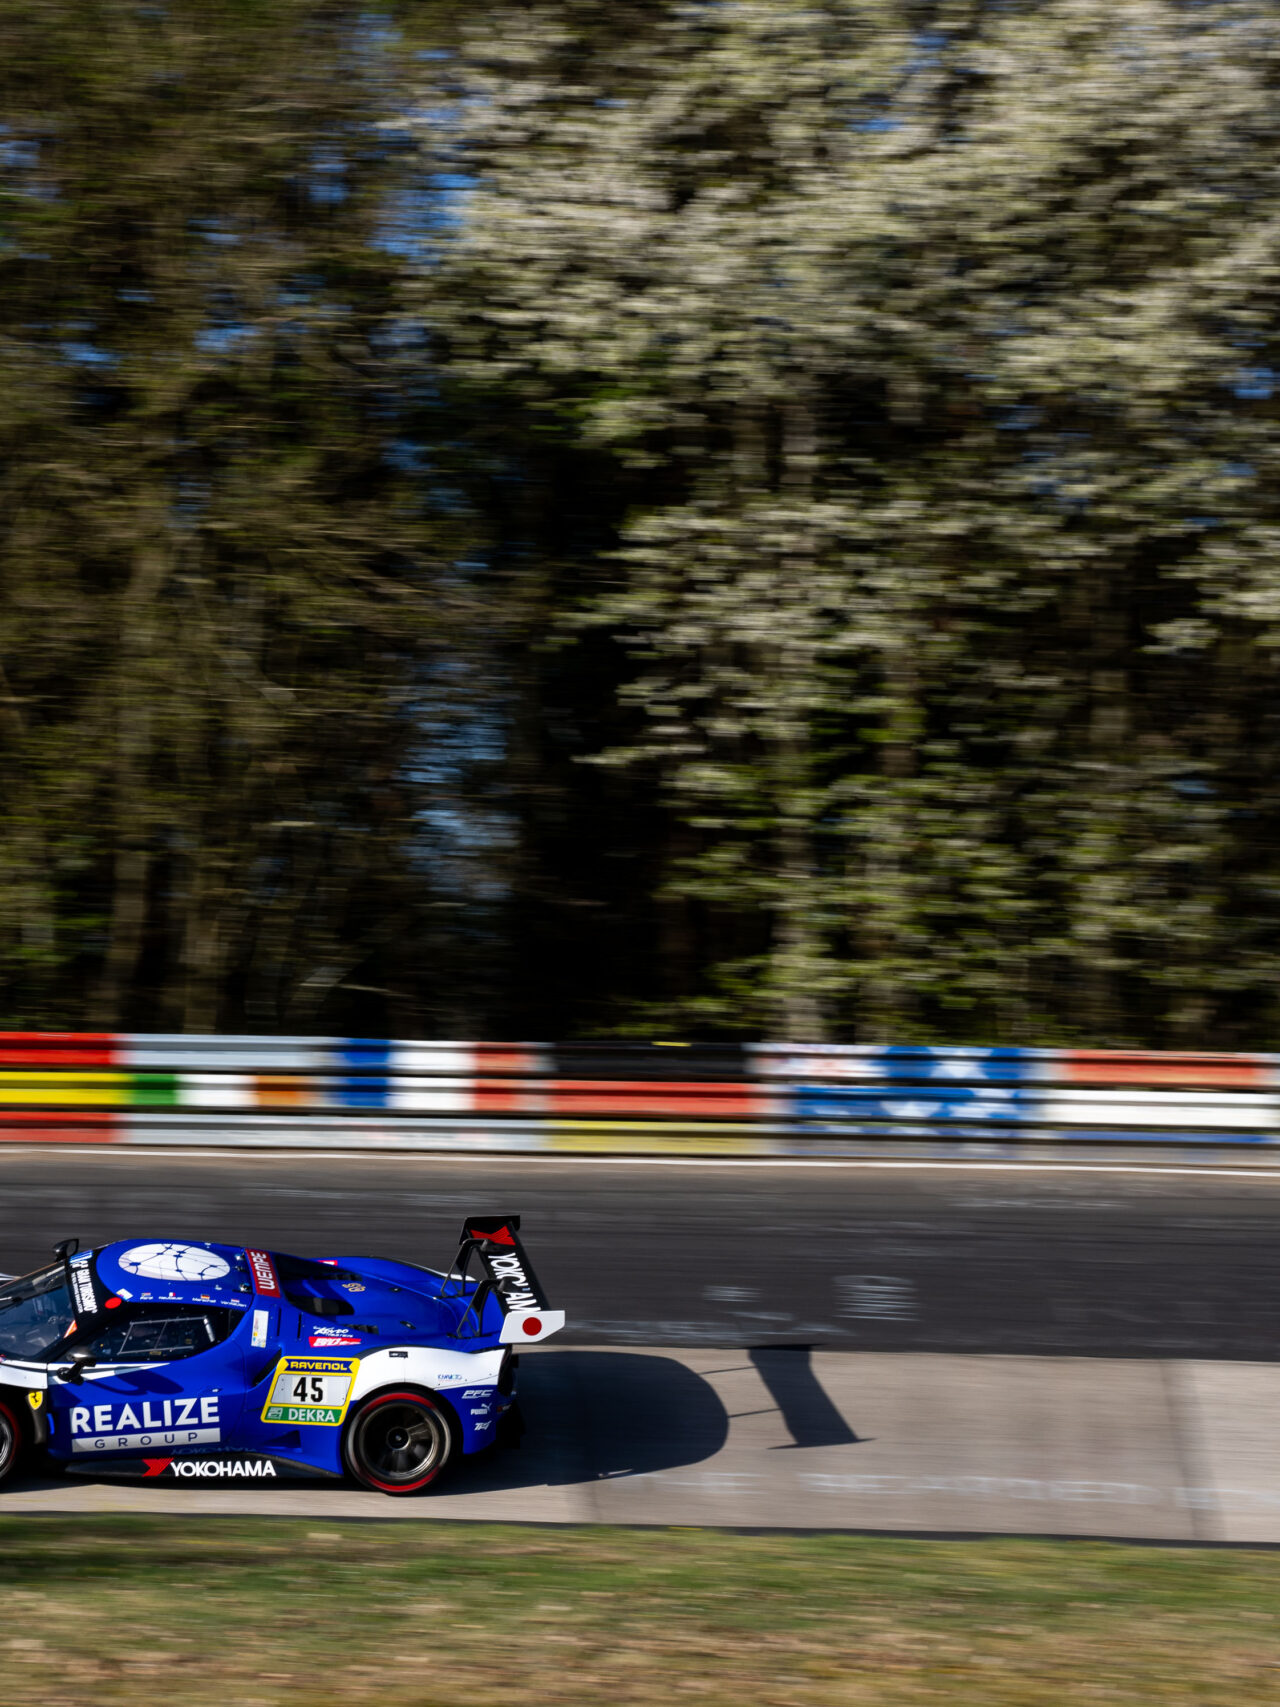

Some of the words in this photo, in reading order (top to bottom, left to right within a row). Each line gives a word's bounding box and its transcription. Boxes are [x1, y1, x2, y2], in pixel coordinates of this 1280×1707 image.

[251, 1251, 276, 1290] WEMPE
[290, 1361, 348, 1371] RAVENOL
[293, 1376, 323, 1403] 45
[71, 1396, 220, 1434] REALIZE
[288, 1408, 336, 1422] DEKRA
[94, 1432, 199, 1449] GROUP
[170, 1460, 277, 1477] YOKOHAMA
